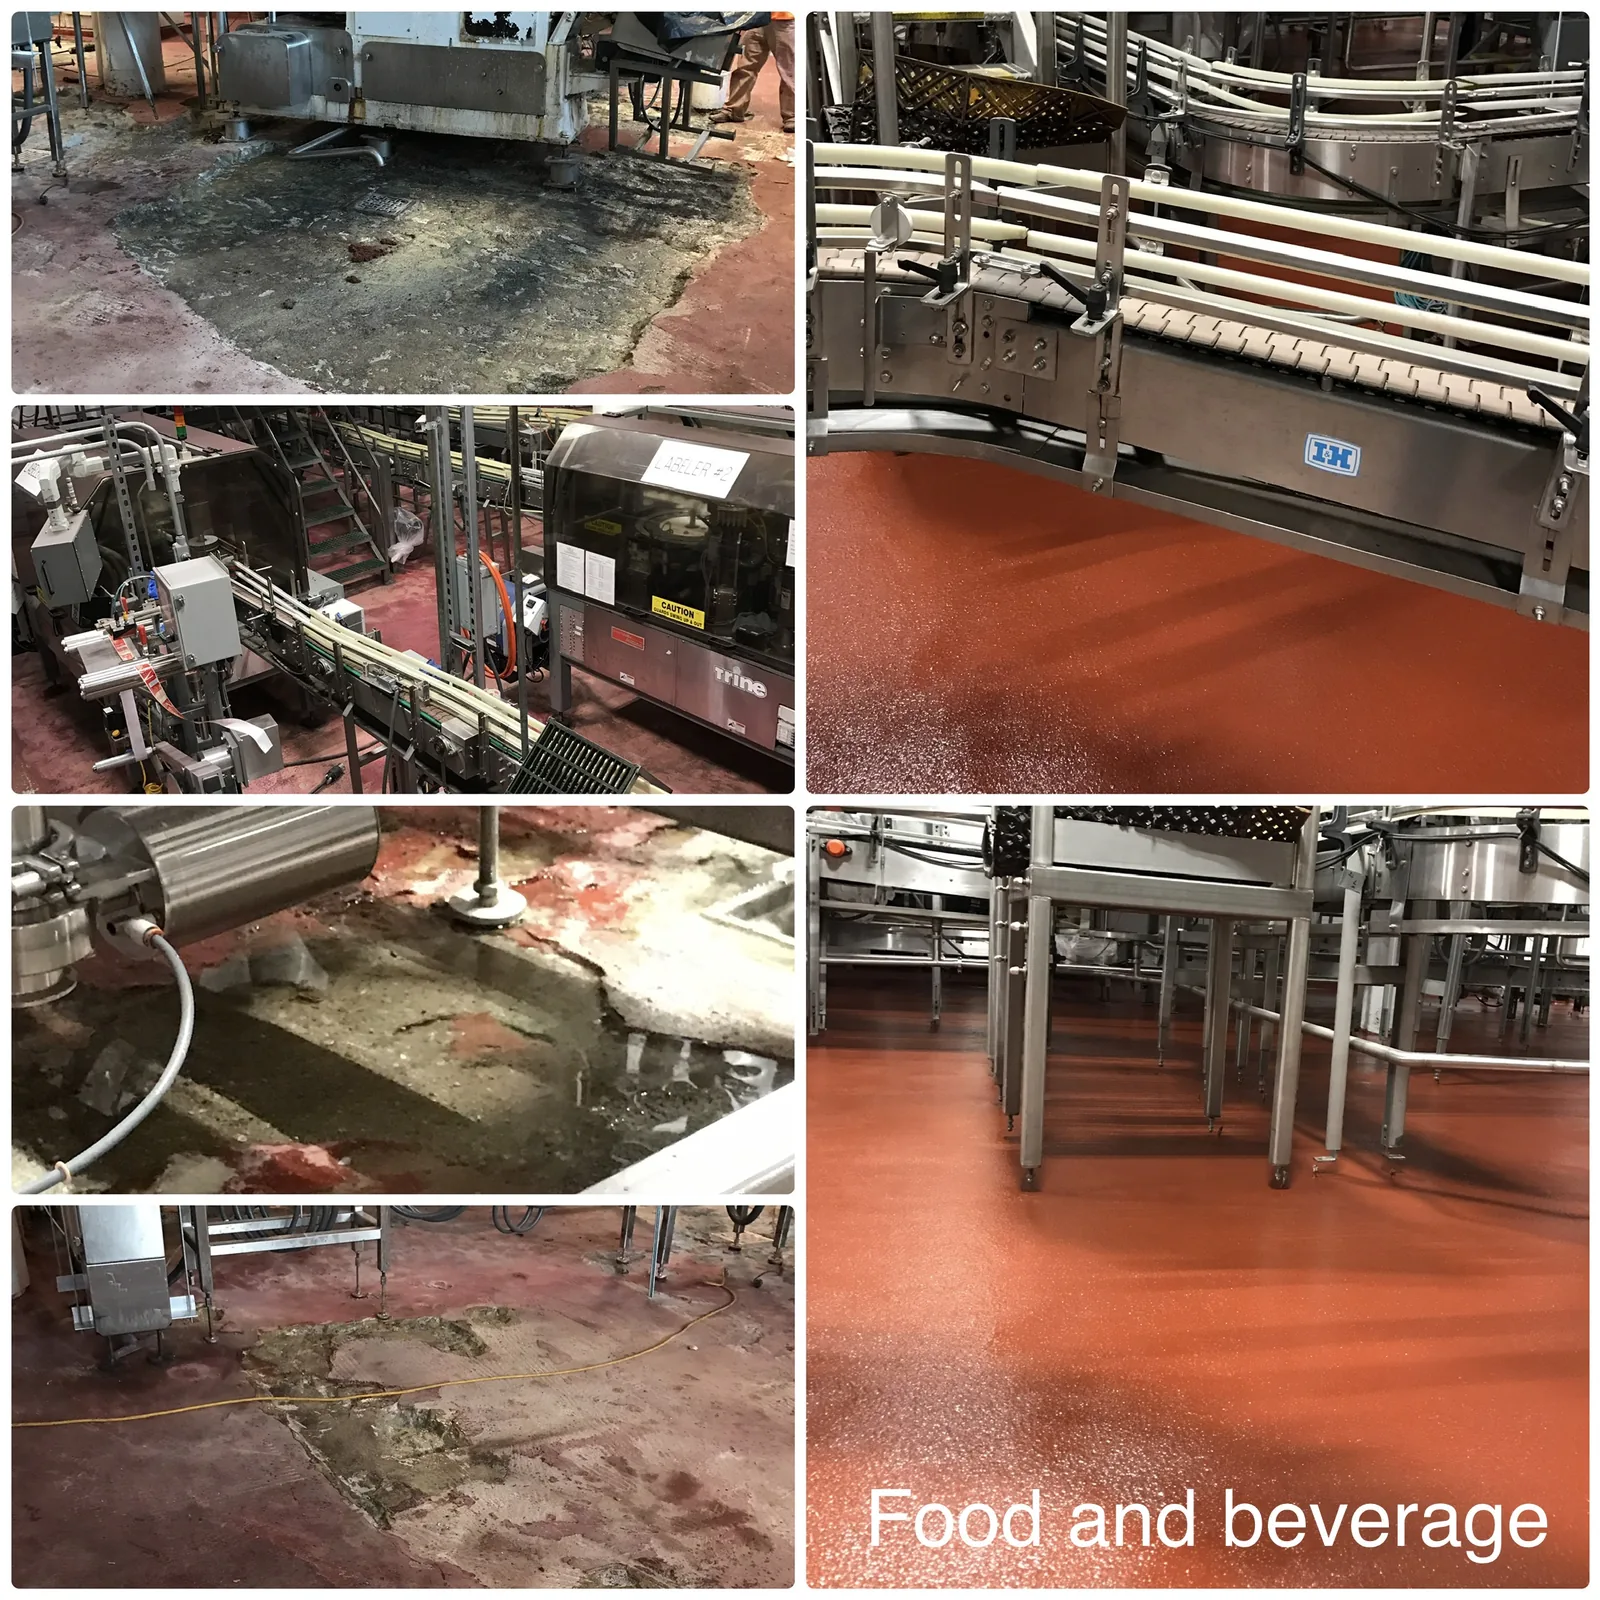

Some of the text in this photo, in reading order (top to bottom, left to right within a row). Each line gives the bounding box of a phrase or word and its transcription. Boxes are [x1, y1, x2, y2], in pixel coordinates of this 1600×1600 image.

[654, 456, 733, 482] LABELER #2
[653, 606, 670, 616] GUARDS
[669, 612, 683, 621] SWING
[661, 601, 695, 619] CAUTION
